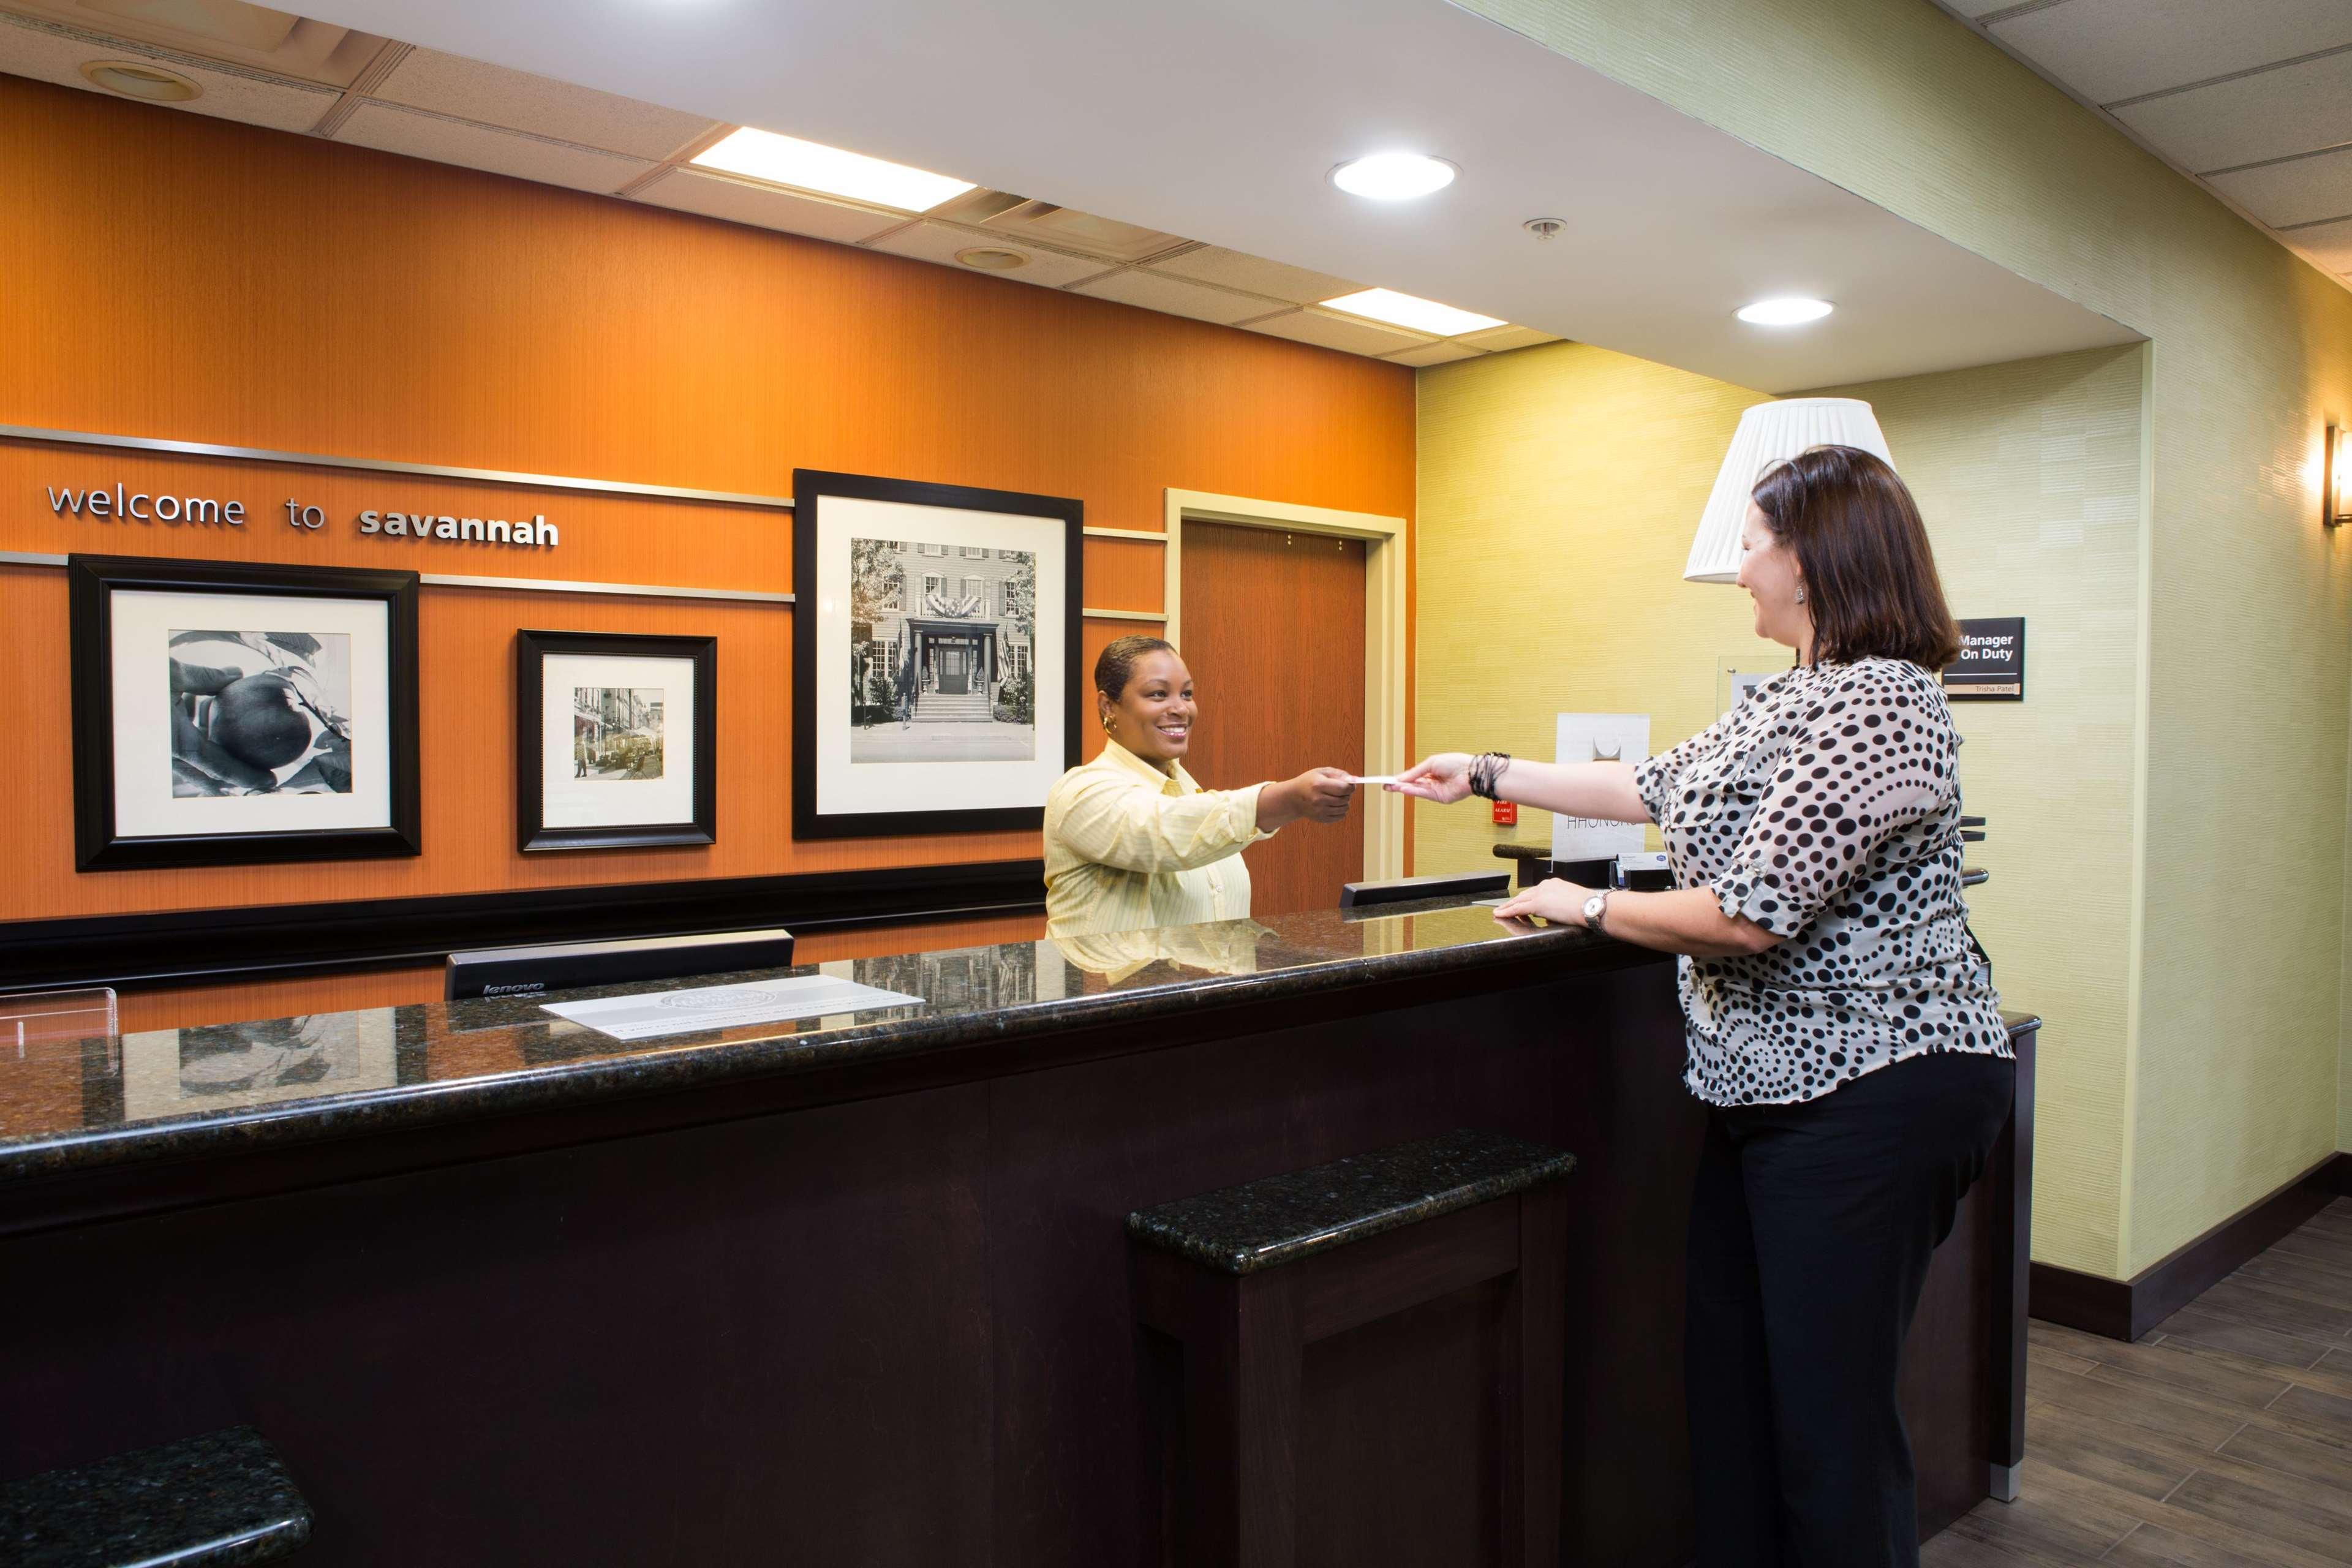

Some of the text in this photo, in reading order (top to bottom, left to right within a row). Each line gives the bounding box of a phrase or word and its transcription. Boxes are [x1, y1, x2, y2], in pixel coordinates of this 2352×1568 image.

[47, 483, 559, 546] welcome to savannah
[1959, 635, 2013, 648] Manager
[1961, 648, 2013, 662] On Duty
[1567, 815, 1637, 829] HHON
[483, 983, 545, 995] lenovo
